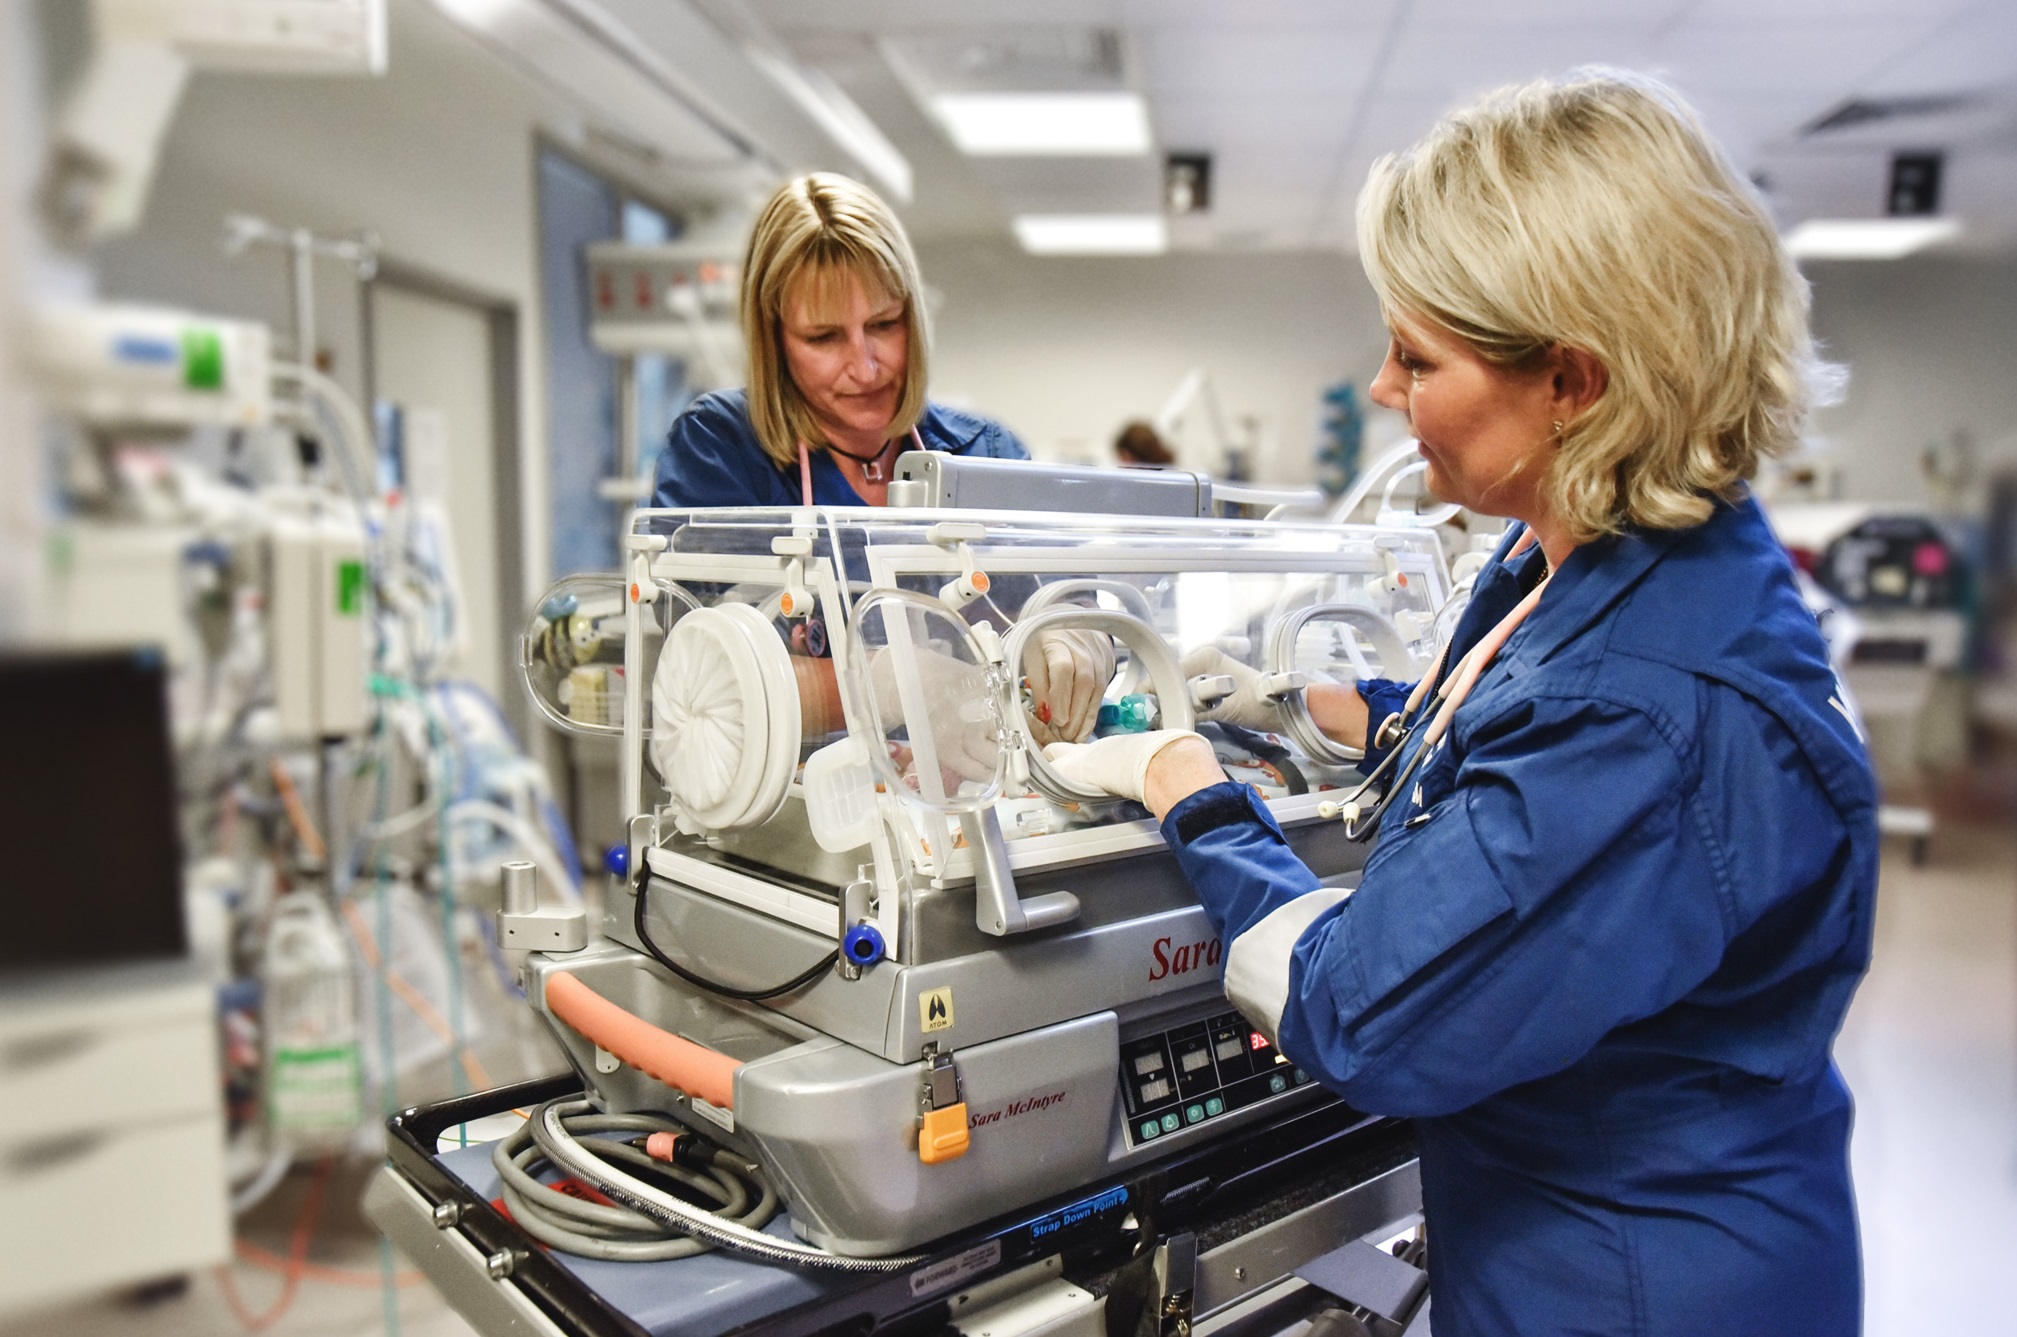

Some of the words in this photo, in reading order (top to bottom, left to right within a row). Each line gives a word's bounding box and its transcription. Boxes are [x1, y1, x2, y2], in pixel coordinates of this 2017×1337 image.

[1149, 937, 1222, 982] Sara
[929, 1020, 947, 1029] ATOM
[968, 1111, 1001, 1129] Sara
[1004, 1091, 1066, 1118] McIntyre
[1033, 1220, 1060, 1238] Strap
[1064, 1208, 1091, 1226] Down
[1093, 1197, 1118, 1214] Point
